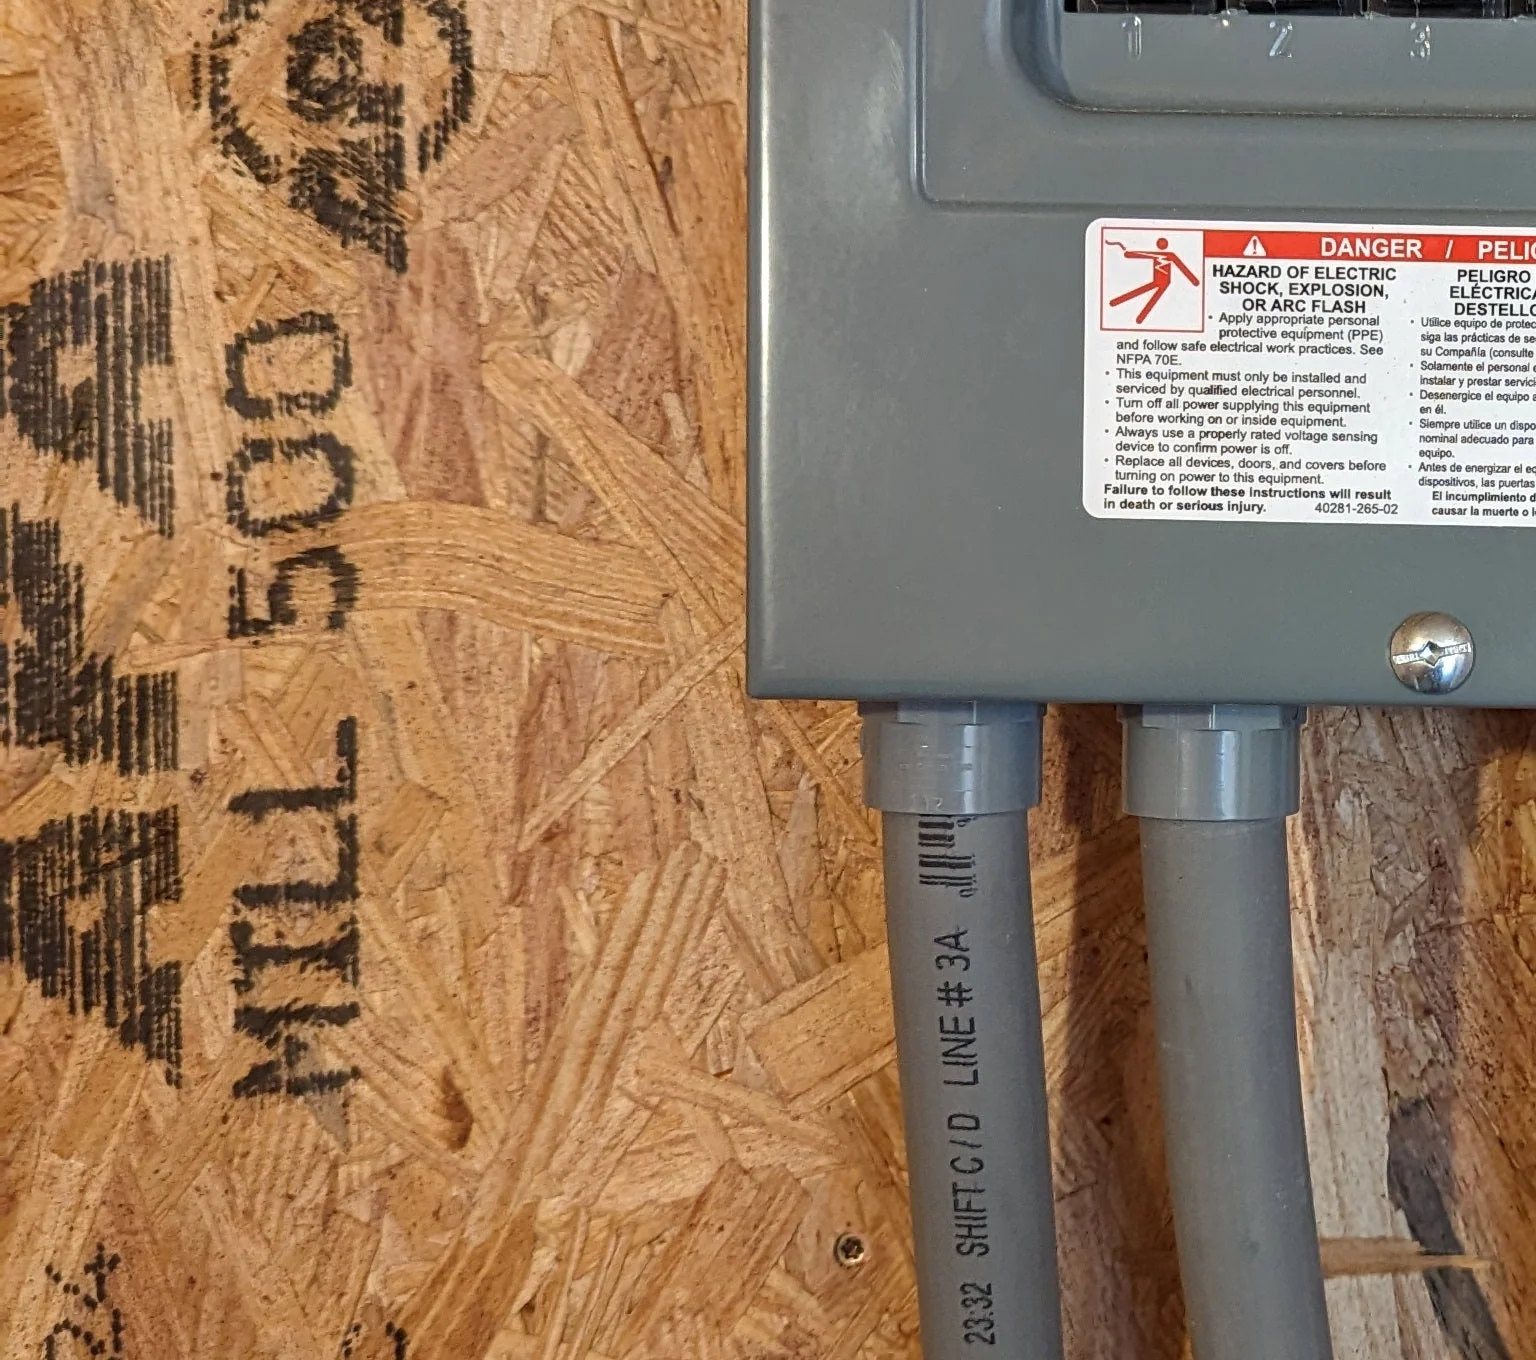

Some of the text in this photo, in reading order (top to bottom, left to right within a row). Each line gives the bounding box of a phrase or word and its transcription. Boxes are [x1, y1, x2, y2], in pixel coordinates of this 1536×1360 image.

[1269, 19, 1293, 58] 2
[1409, 21, 1432, 59] 3
[1320, 237, 1422, 259] DANGER
[1212, 264, 1397, 280] HAZARD OF ELECTRIC
[1456, 269, 1531, 285] PELIGRO
[1219, 280, 1388, 297] SHOCK, EXPLOSION,
[1242, 298, 1366, 313] OR ARC FLASH
[1217, 312, 1380, 329] Apply appropriate personal
[1218, 327, 1383, 343] protective equipment (PPE)
[1116, 353, 1182, 365] NFPA 70E.
[1117, 397, 1371, 415] Turn off all power supplying this equipment
[1313, 502, 1399, 514] 40281-265-02
[223, 311, 361, 1100] MILL 500
[933, 927, 971, 973] 3A
[938, 1016, 979, 1088] LINE
[952, 1184, 989, 1258] SHIFT
[959, 1282, 998, 1346] 23:32
